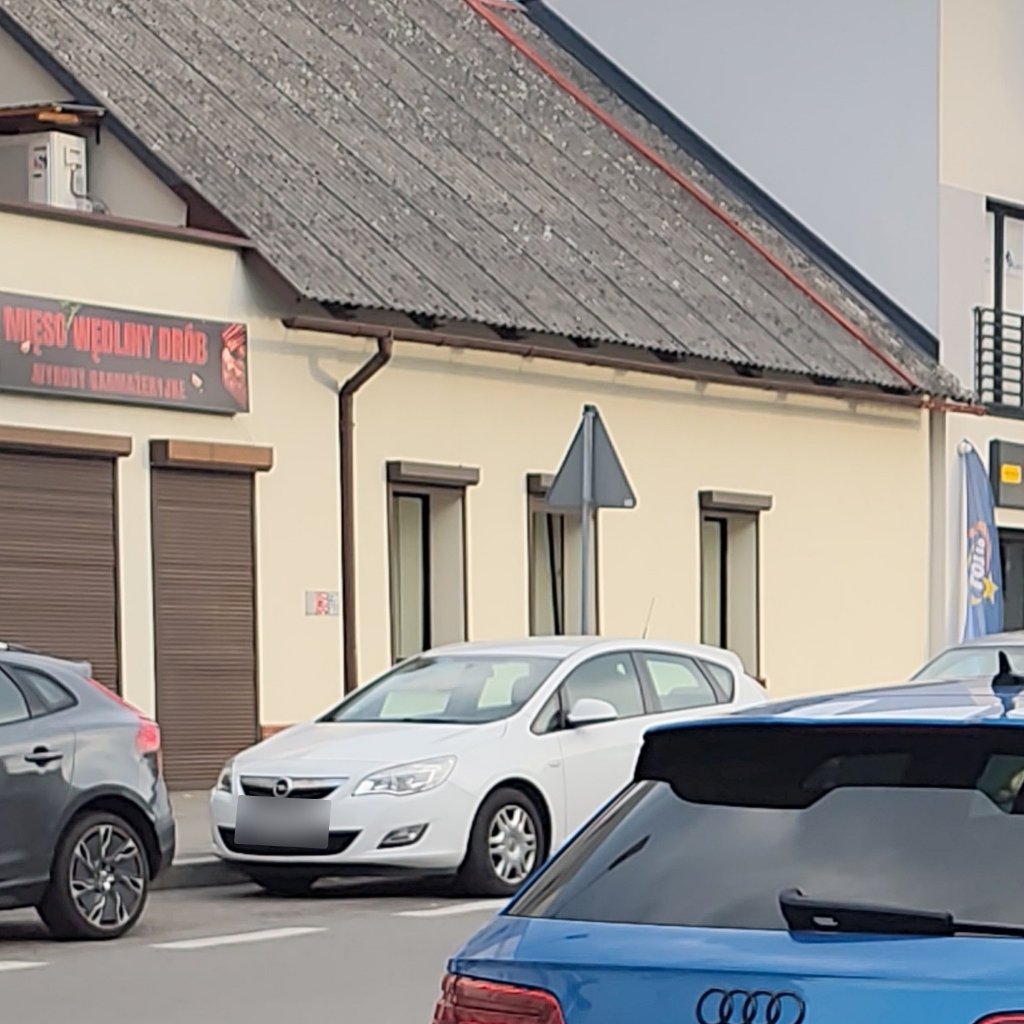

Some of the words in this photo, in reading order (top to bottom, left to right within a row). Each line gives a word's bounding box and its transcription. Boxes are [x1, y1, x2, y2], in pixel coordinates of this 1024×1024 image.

[3, 304, 68, 357] MIĘSO
[73, 315, 153, 364] WĘDLINY
[158, 322, 209, 366] DRÓB
